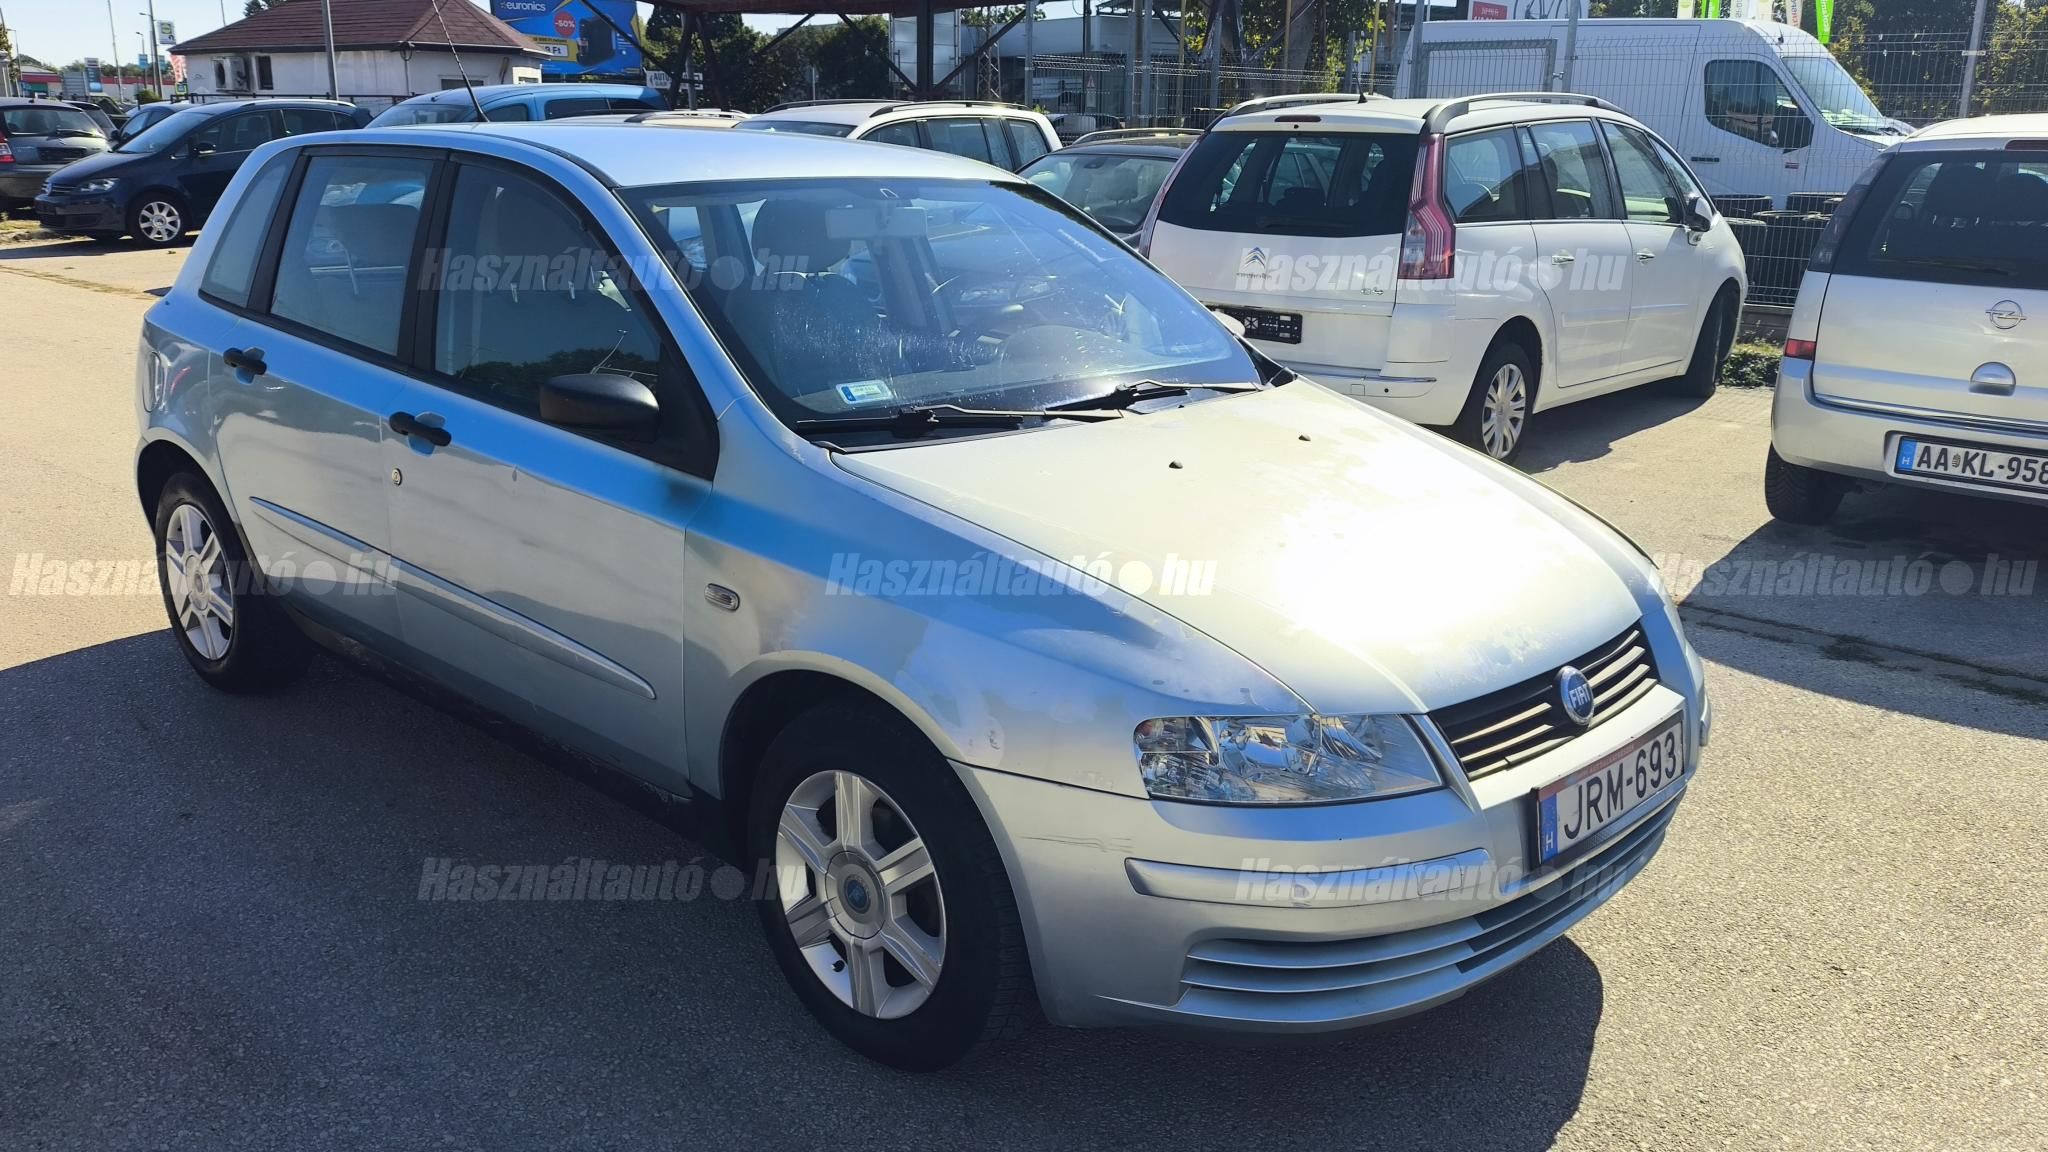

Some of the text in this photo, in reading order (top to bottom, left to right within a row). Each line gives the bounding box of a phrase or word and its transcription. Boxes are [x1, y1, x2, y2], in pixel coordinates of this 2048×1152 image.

[506, 1, 546, 11] euronics
[1902, 456, 1911, 465] H
[1917, 445, 1949, 472] AA
[1569, 683, 1590, 709] FIAT
[1564, 731, 1677, 840] JRM-693
[1545, 831, 1554, 852] H
